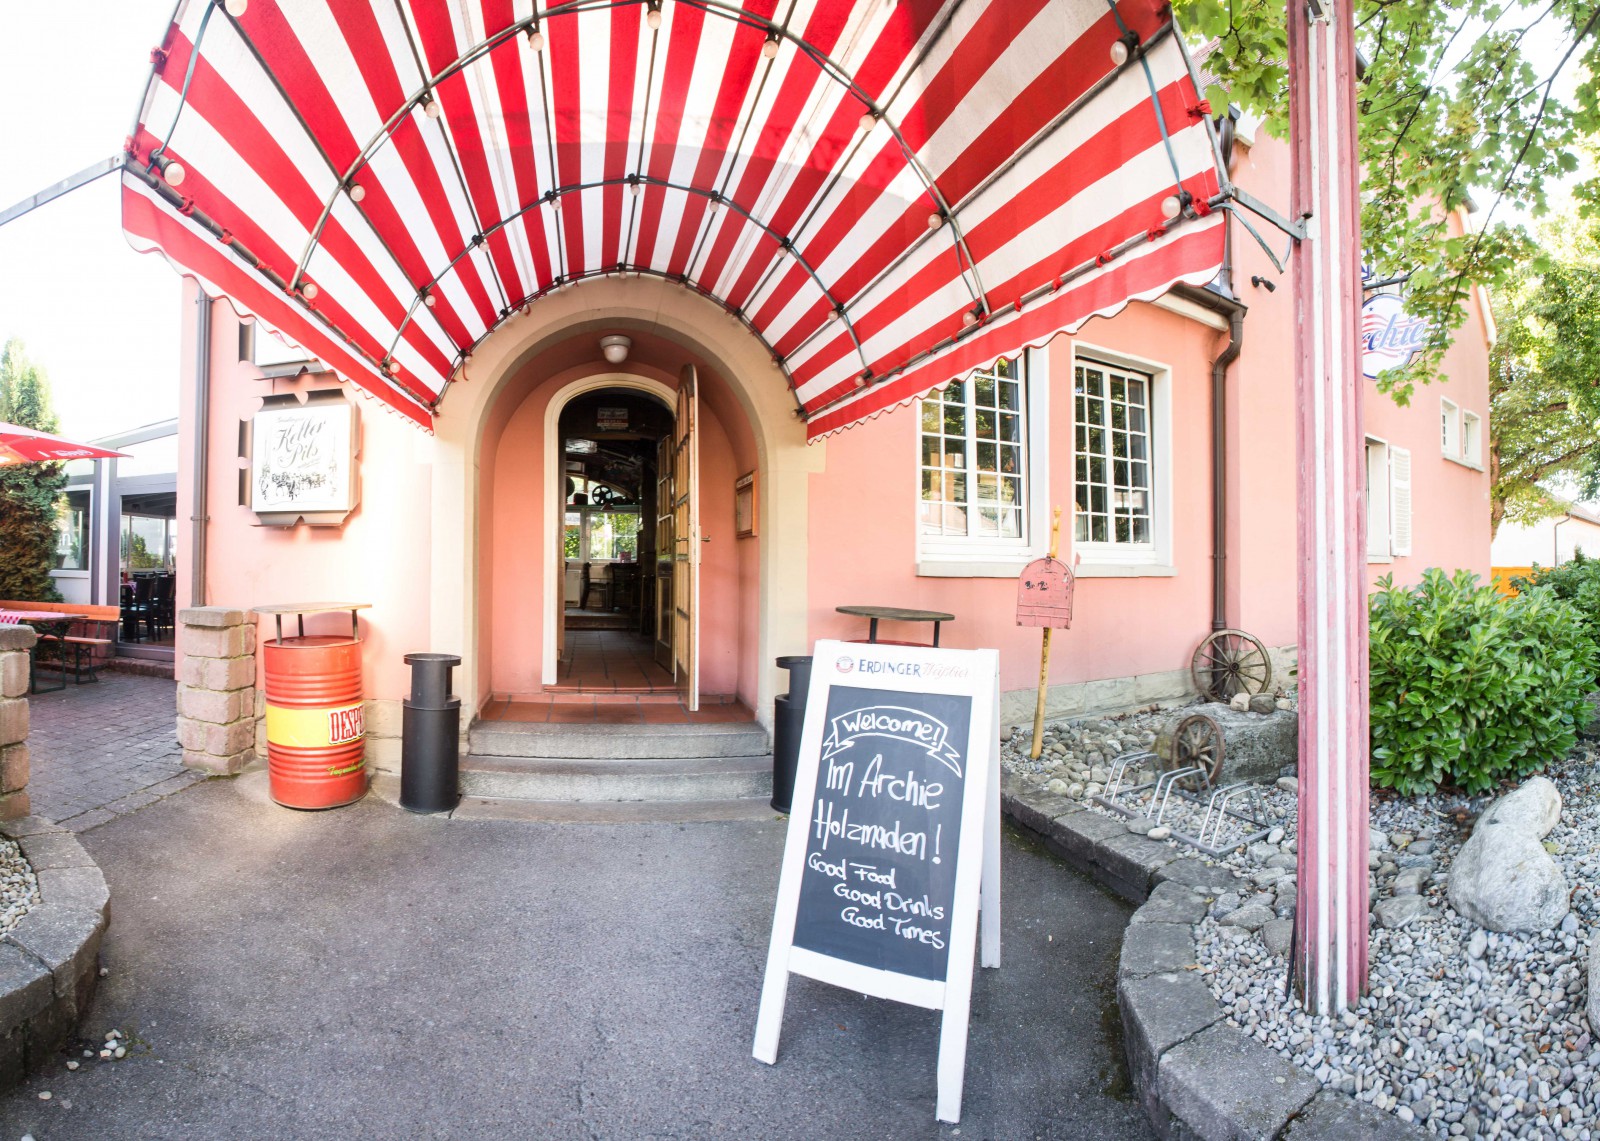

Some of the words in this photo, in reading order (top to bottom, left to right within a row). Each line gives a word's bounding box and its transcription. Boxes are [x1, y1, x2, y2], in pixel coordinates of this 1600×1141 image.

[272, 416, 326, 453] Keller
[277, 438, 319, 469] Pils
[858, 659, 921, 677] ERDINGER
[826, 757, 854, 797] Im
[858, 753, 944, 810] Archie
[808, 852, 847, 881] Good
[849, 862, 897, 890] Food
[833, 883, 882, 910] Good
[884, 892, 945, 920] Drinks
[841, 906, 887, 931] Good
[888, 916, 945, 950] Times
